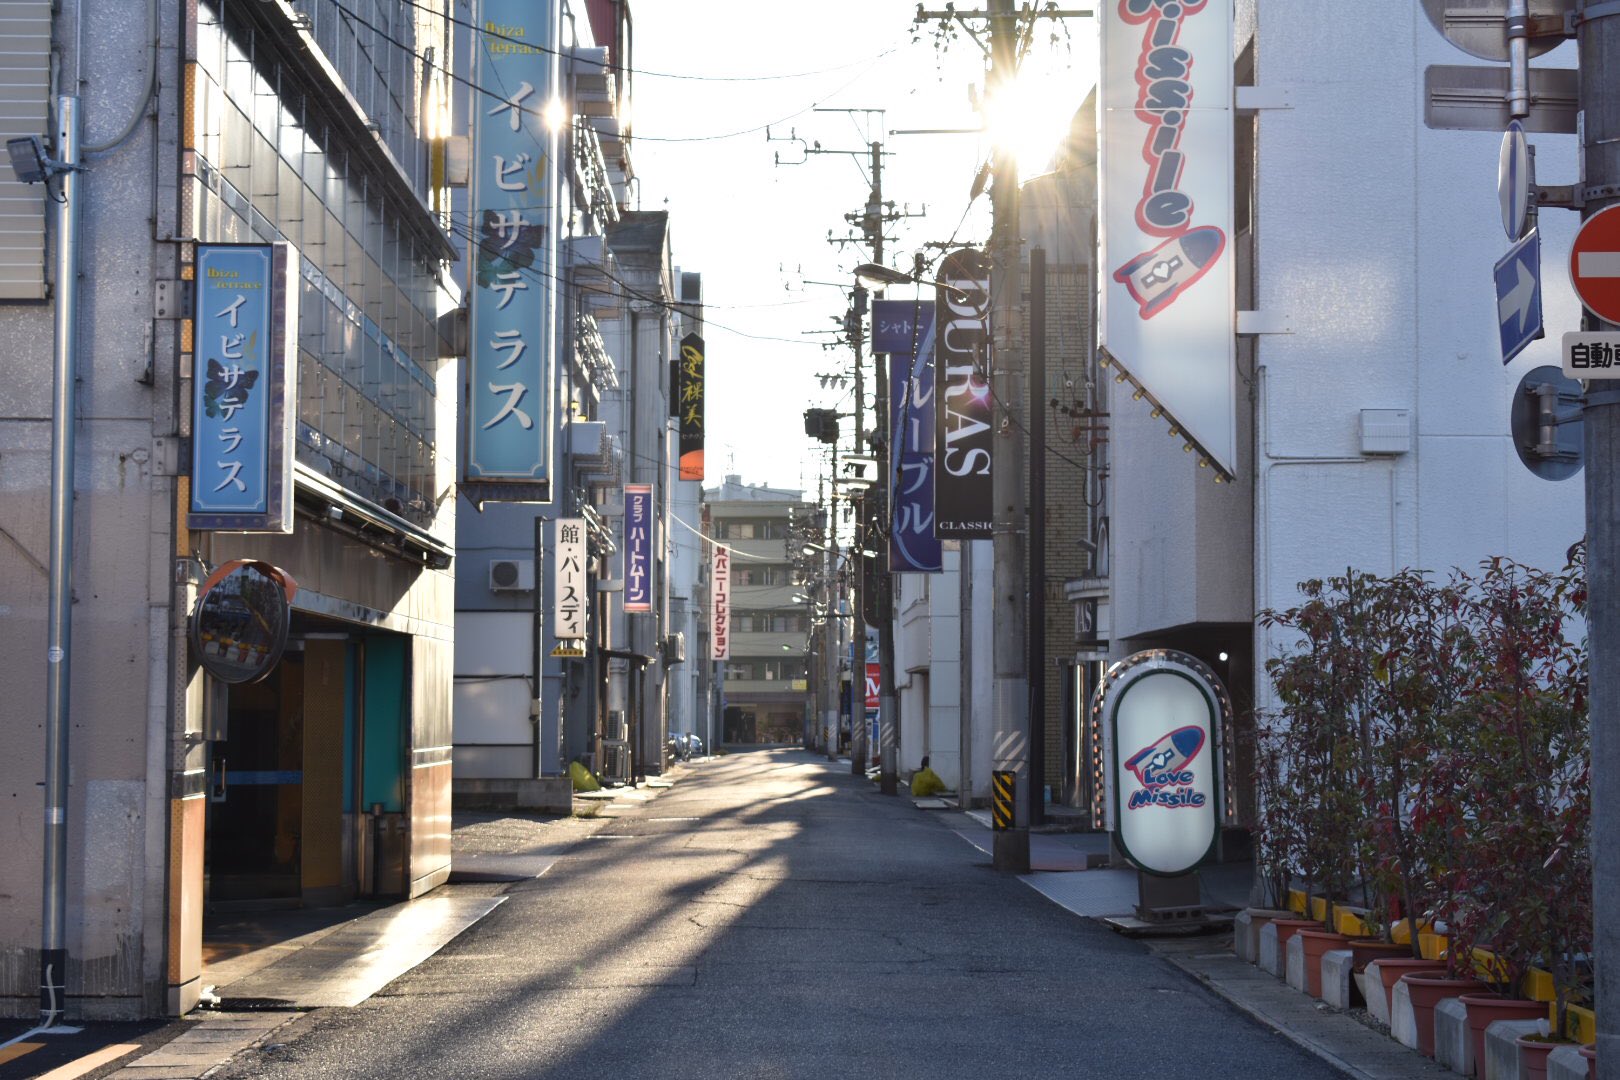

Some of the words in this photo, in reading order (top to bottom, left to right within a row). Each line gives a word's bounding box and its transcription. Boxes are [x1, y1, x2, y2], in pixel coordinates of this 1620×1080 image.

[485, 21, 525, 37] Ibiza
[207, 267, 239, 278] Ibiza
[481, 81, 535, 430] イビサテラス
[880, 320, 925, 335] シャトー
[214, 294, 247, 493] イビサテラス
[944, 274, 990, 477] DURAS
[898, 377, 934, 535] ルーブル
[630, 527, 645, 601] ハートムーン
[1129, 787, 1206, 810] Missile
[1142, 767, 1195, 787] Love
